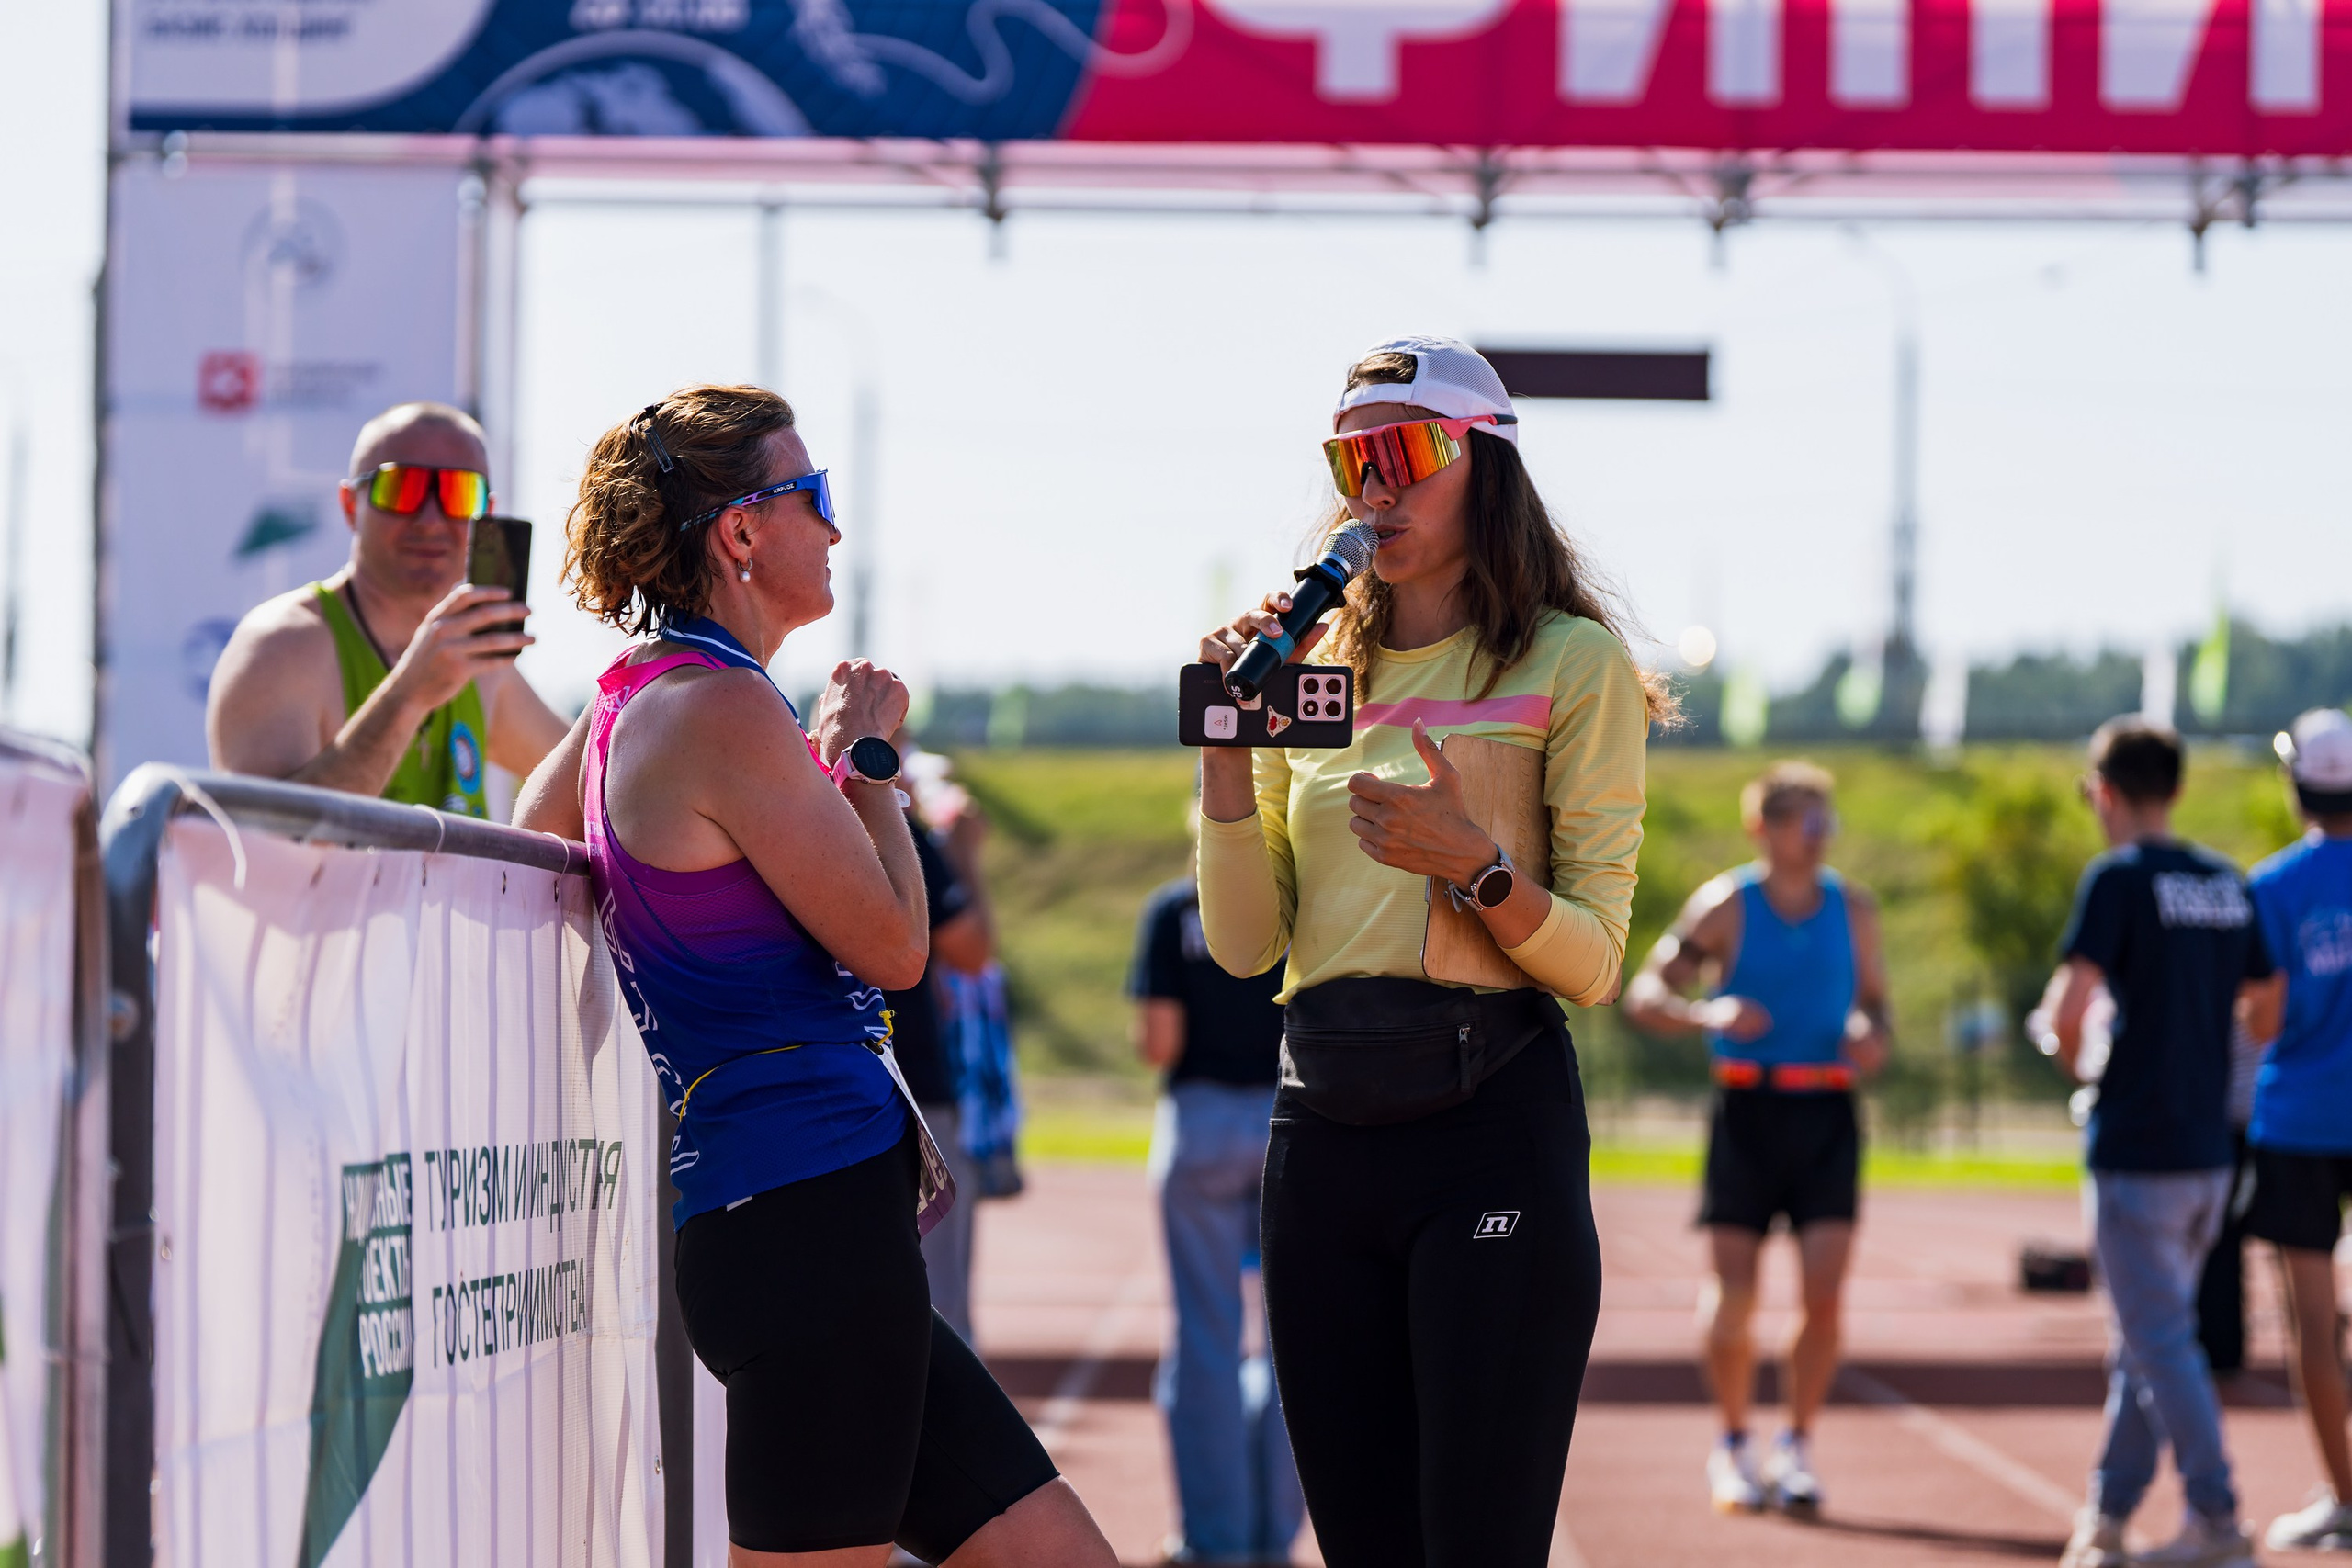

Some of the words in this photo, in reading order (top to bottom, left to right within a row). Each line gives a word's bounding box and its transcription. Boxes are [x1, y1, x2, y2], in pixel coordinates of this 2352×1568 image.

[424, 1145, 509, 1233] ТУРИЗМ
[514, 1145, 527, 1221] И
[432, 1258, 587, 1369] ГОСТЕПРИИМСТВА
